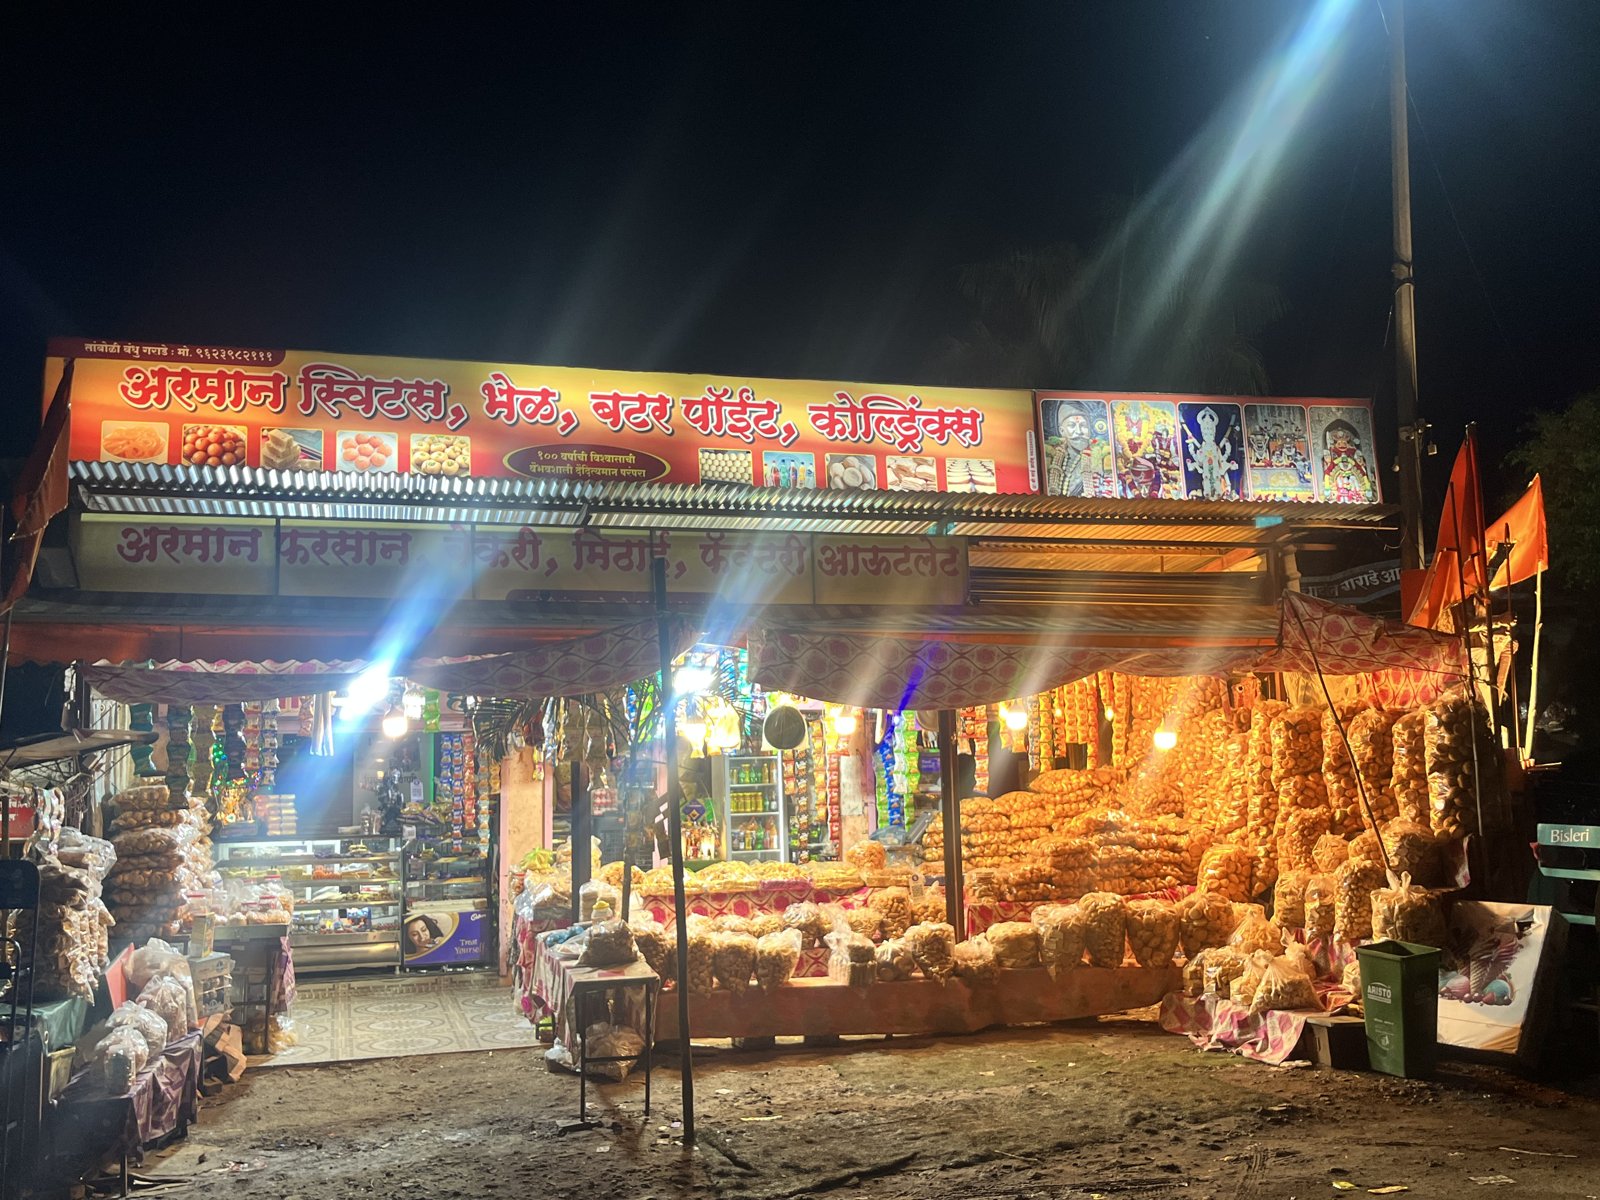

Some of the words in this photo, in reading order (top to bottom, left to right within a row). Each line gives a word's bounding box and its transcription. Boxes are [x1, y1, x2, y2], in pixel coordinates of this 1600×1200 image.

[123, 342, 140, 358] बंधु
[142, 344, 169, 357] गराडे
[119, 363, 286, 413] अरमान
[297, 362, 470, 430] स्विटस,
[480, 370, 579, 437] भेळ,
[587, 389, 673, 435] बटर
[681, 383, 799, 447] पॉईंट,
[807, 390, 984, 453] कोल्ड्रिंक्स
[537, 449, 557, 461] १००
[560, 449, 588, 463] वर्षाची
[590, 450, 636, 465] विश्वासाची
[117, 525, 263, 564] अरमान
[817, 536, 960, 577] आऊटलेट
[1550, 828, 1590, 843] Bisleri
[1367, 984, 1392, 999] ARISTO
